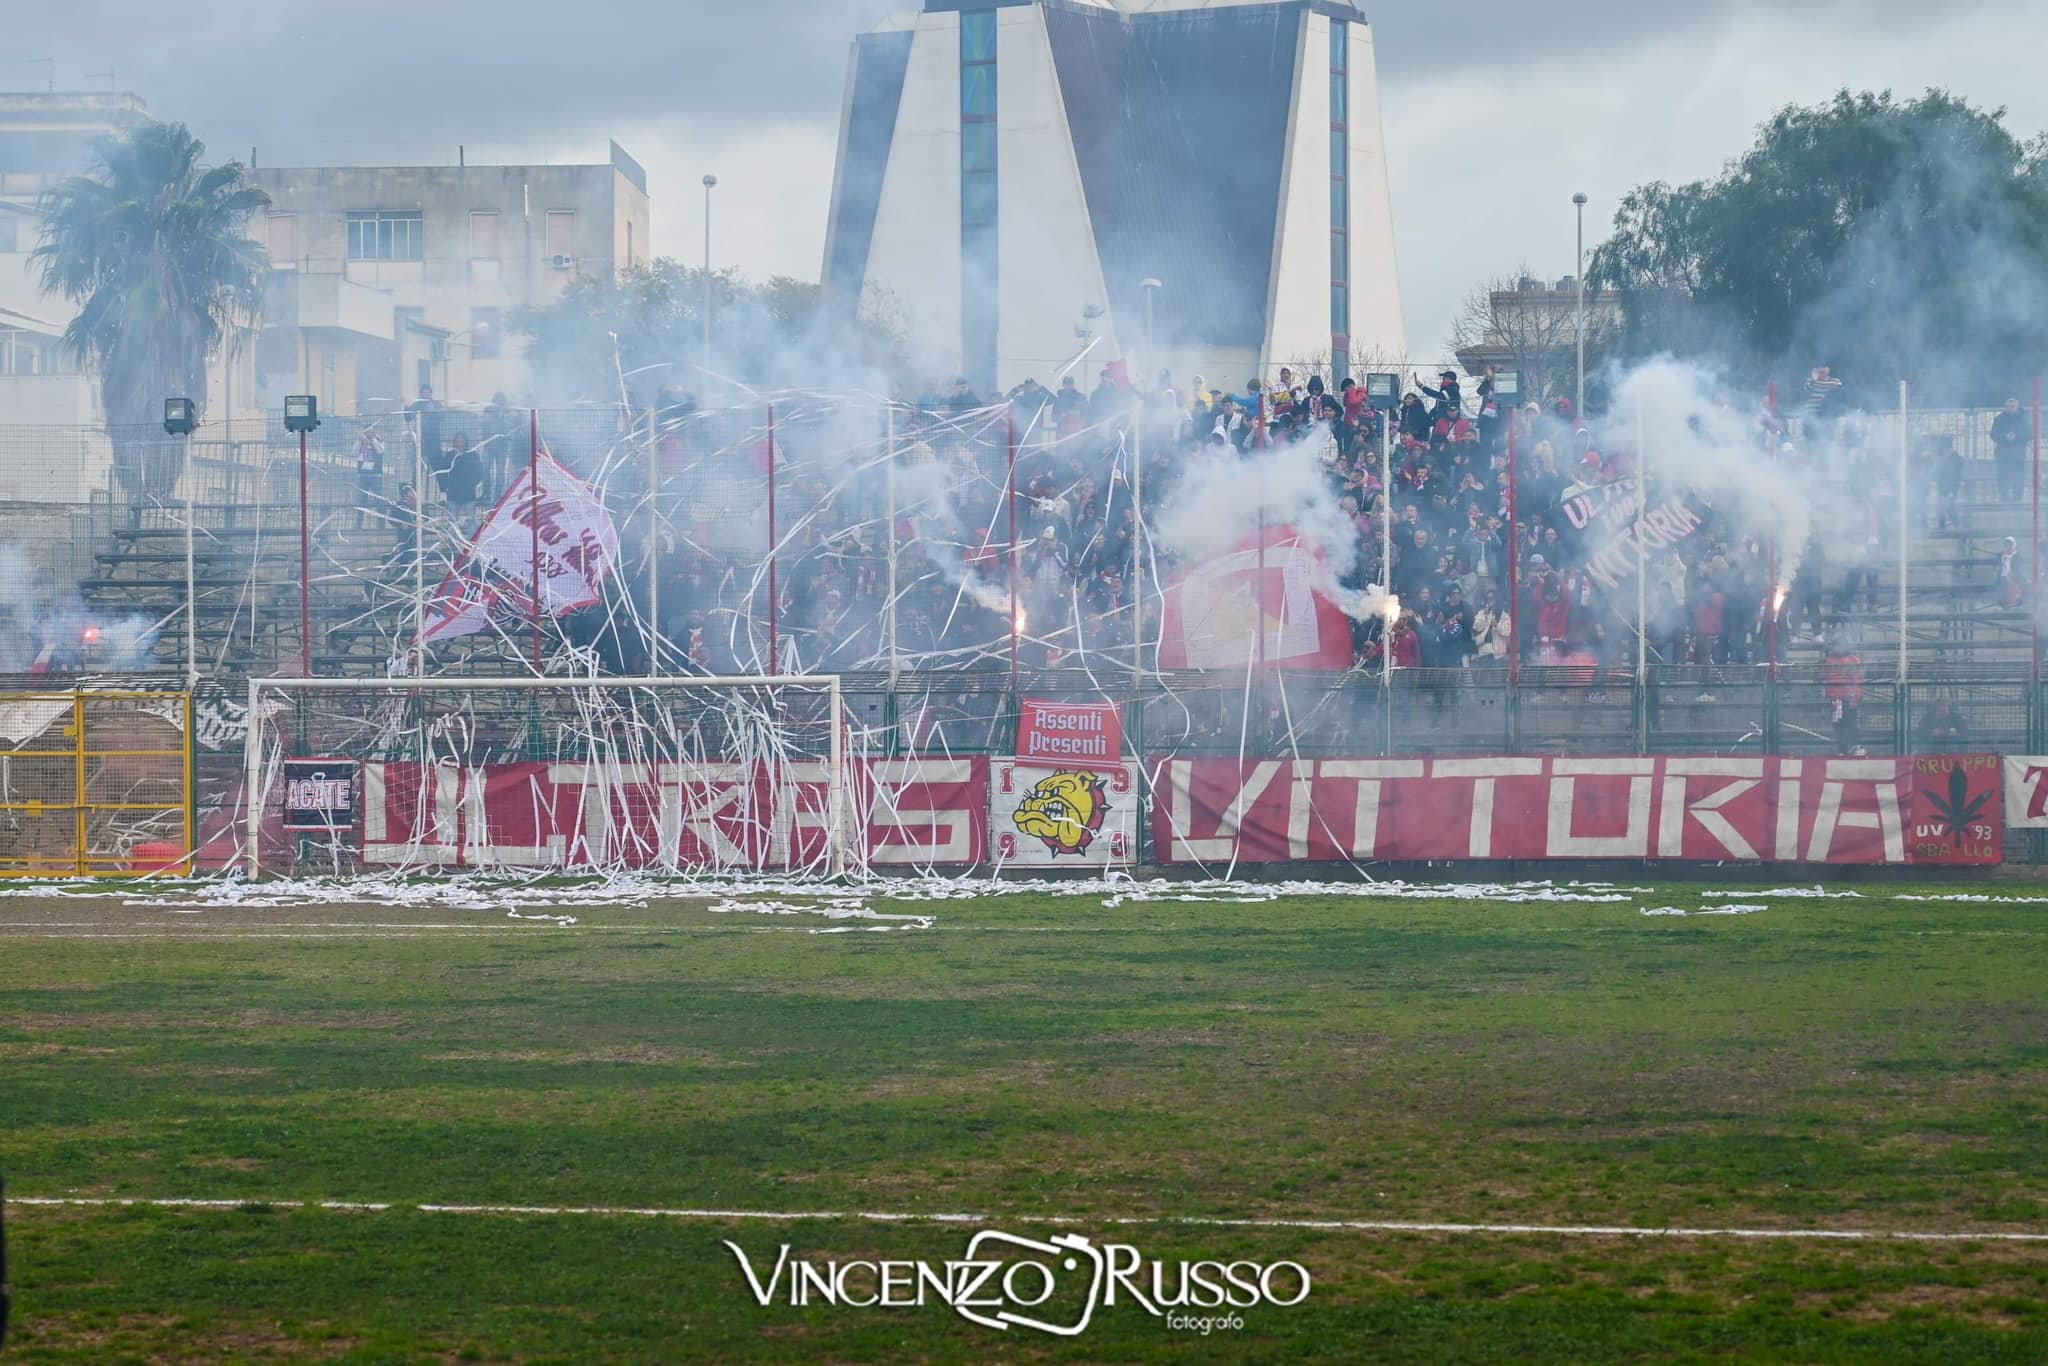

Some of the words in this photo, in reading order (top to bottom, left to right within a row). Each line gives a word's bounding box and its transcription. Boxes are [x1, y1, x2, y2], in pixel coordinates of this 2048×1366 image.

[1034, 709, 1103, 731] Assenti
[1029, 731, 1108, 755] Presenti
[1001, 766, 1015, 794] 1
[1170, 757, 1905, 862] VITTORIA
[1916, 824, 1944, 838] UV
